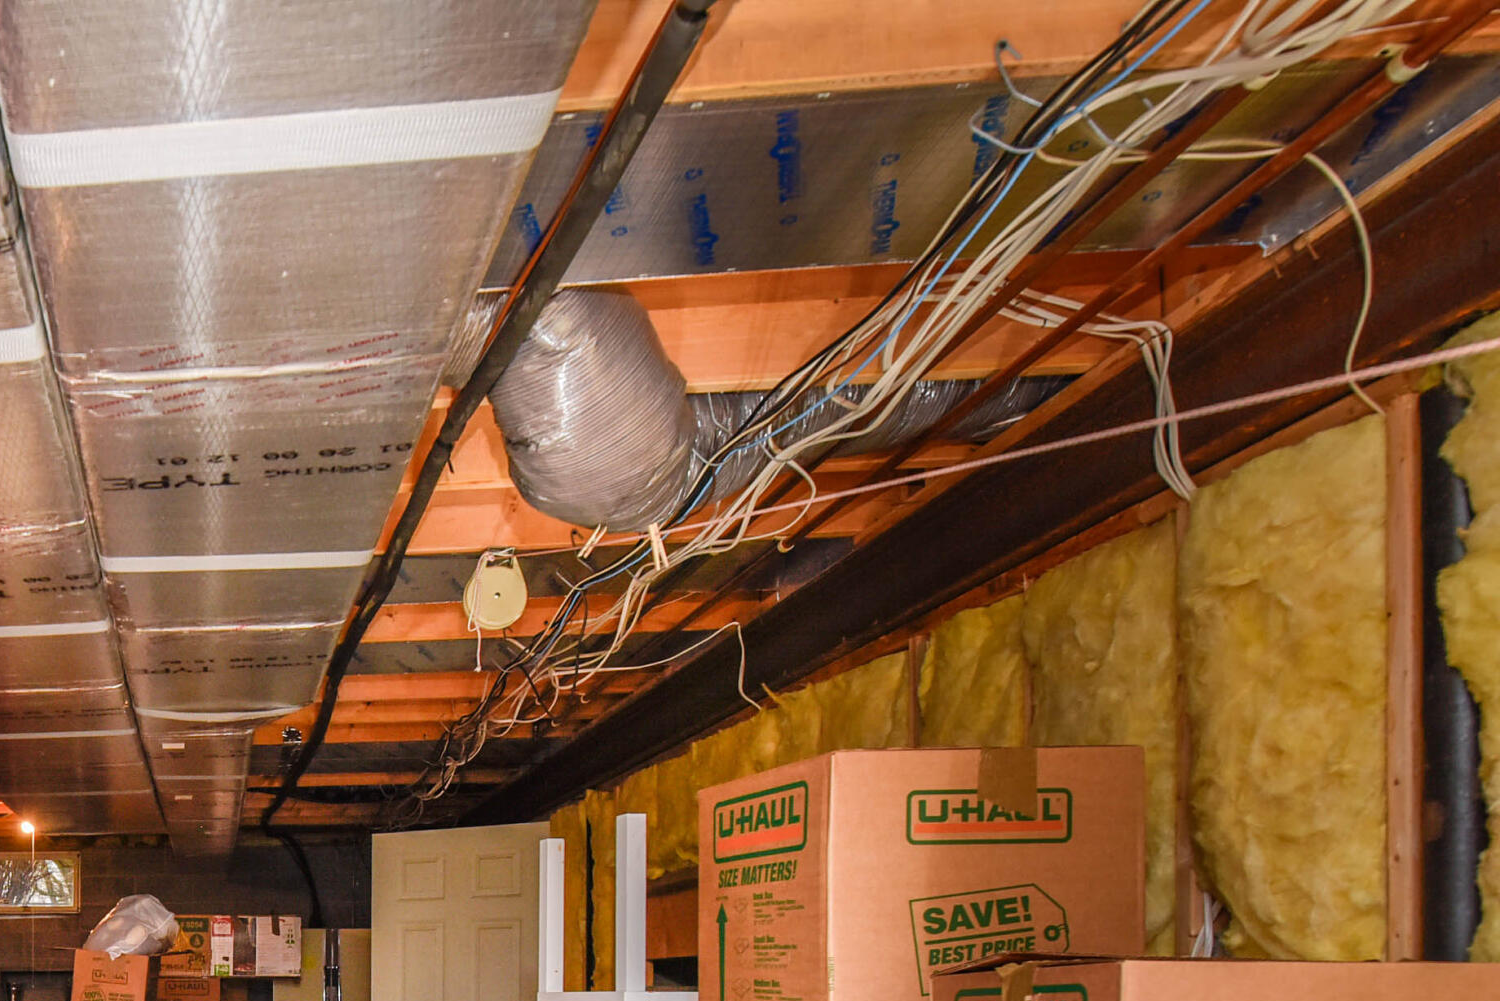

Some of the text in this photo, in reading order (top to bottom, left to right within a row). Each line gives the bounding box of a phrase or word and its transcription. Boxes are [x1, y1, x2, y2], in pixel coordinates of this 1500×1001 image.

[870, 180, 900, 255] THERMOPAN
[100, 462, 391, 492] CORNING TYPE
[719, 796, 800, 838] U-HAUL
[718, 860, 798, 888] SIZE MATTERS!
[923, 896, 1032, 935] SAVE!
[928, 943, 975, 966] BEST
